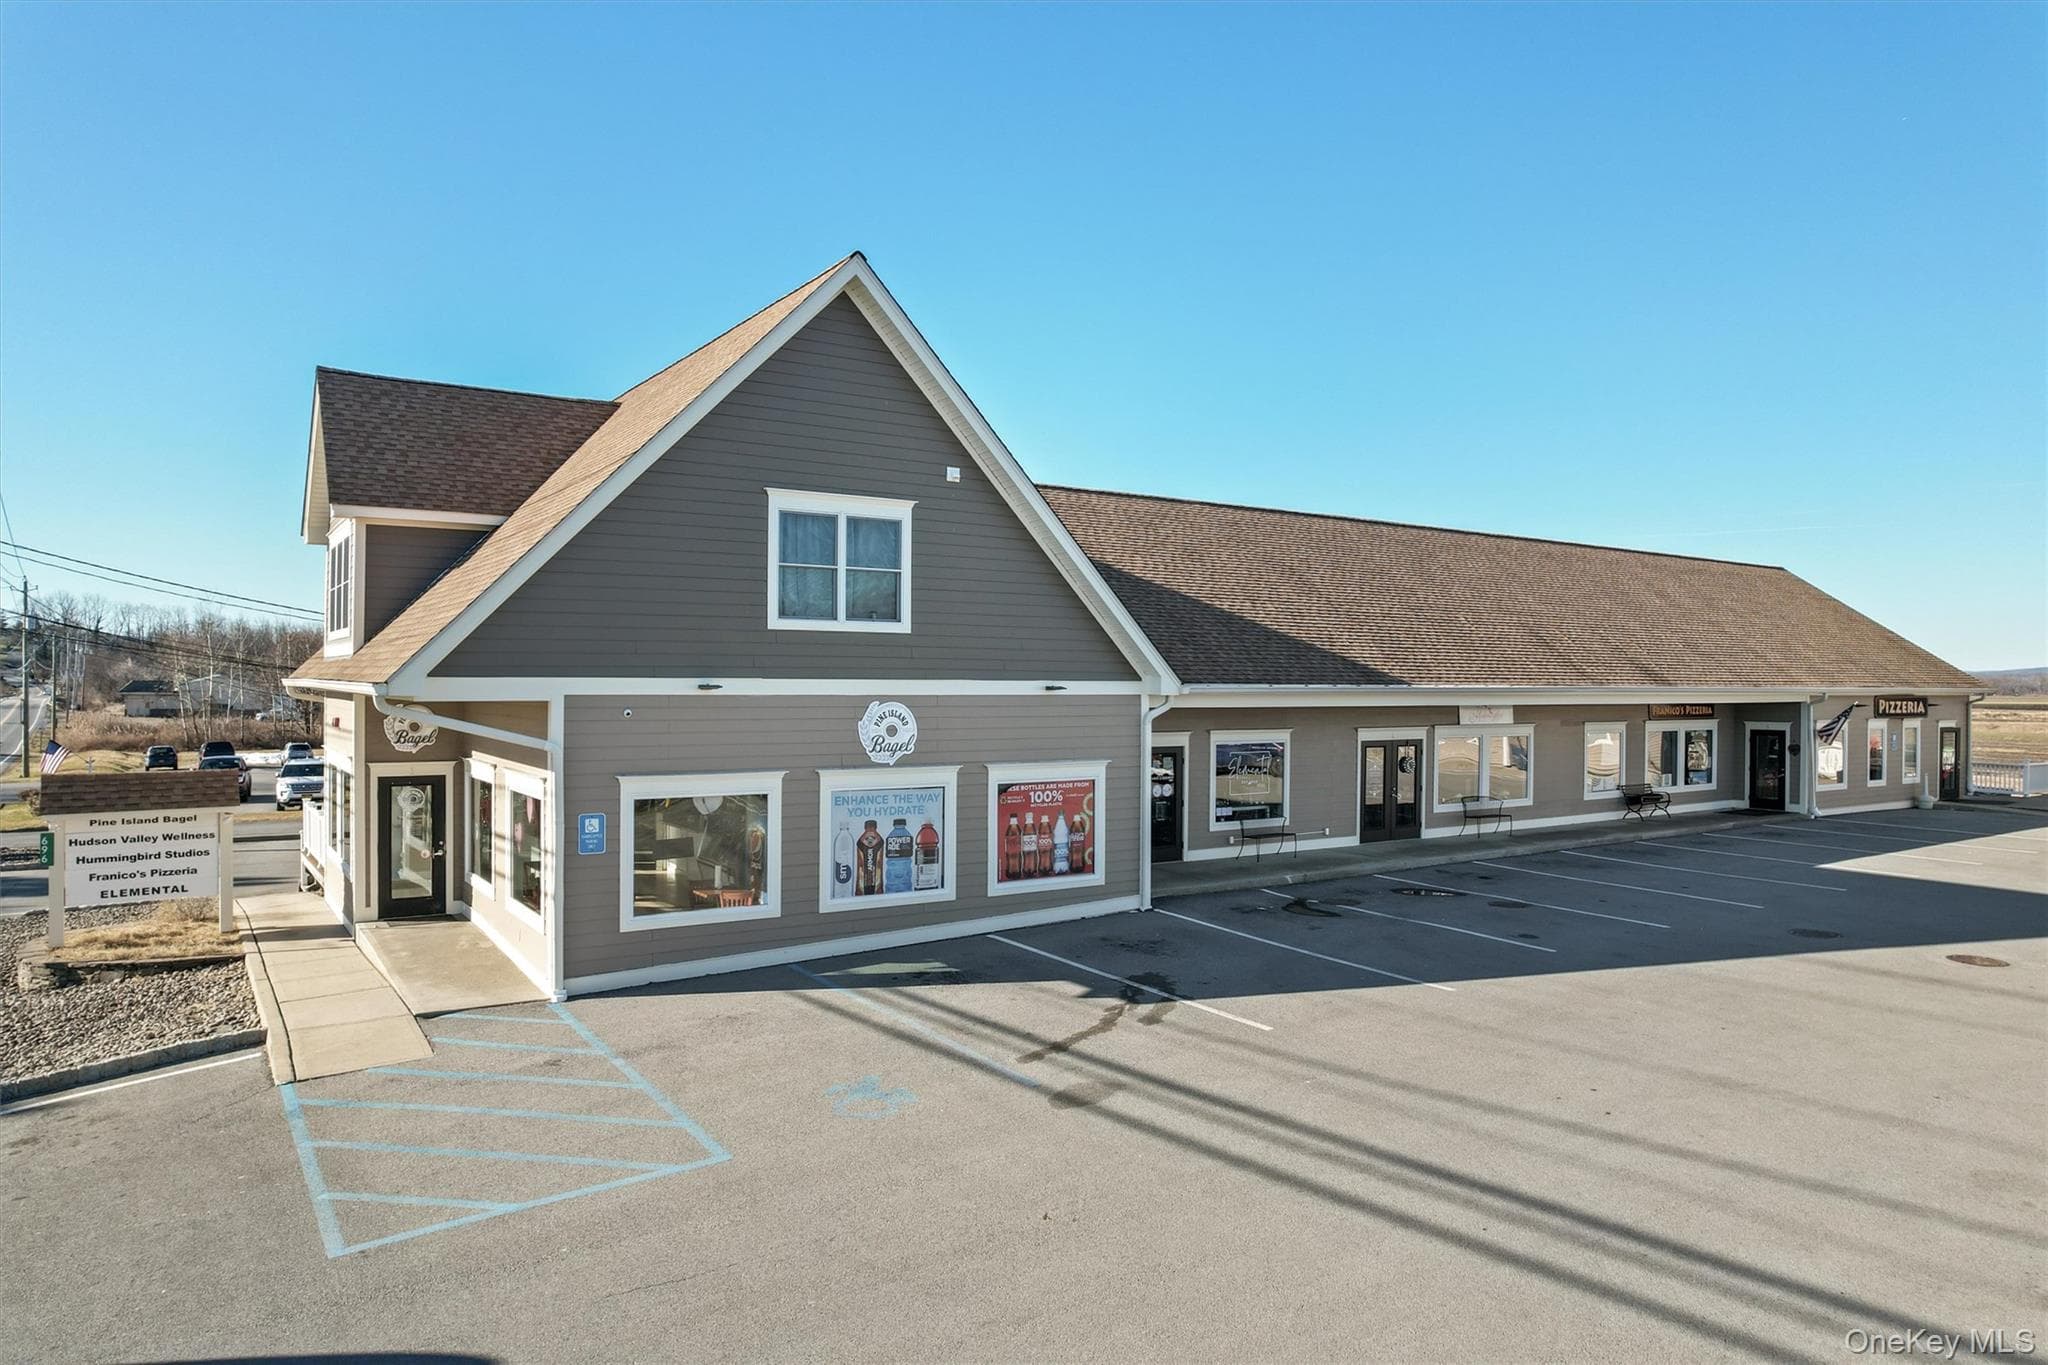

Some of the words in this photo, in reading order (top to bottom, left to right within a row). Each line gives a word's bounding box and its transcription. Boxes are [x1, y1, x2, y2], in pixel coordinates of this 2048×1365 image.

[1685, 704, 1713, 715] PIZZERIA
[1879, 699, 1926, 714] PIZZERIA
[874, 711, 888, 727] PINE
[888, 709, 909, 726] ISLAND
[394, 729, 437, 747] Bagel
[869, 734, 915, 757] Bagel
[1020, 783, 1045, 791] BOTTLES
[834, 794, 888, 807] ENHANCE
[893, 793, 913, 804] THE
[915, 792, 940, 803] WAY
[1029, 790, 1063, 803] 100%
[847, 807, 871, 817] YOU
[874, 805, 925, 816] HYDRATE
[89, 818, 117, 827] Pine
[121, 816, 159, 825] Island
[163, 815, 198, 824] Bagel
[68, 837, 117, 847] Hudson
[120, 833, 159, 845] Valley
[162, 831, 216, 841] Wellness
[887, 836, 911, 845] POWER
[76, 851, 161, 865] Hummingbird
[165, 848, 211, 859] Studios
[88, 870, 147, 882] Franico's
[150, 867, 198, 878] Pizzeria
[100, 884, 189, 899] ELEMENTAL
